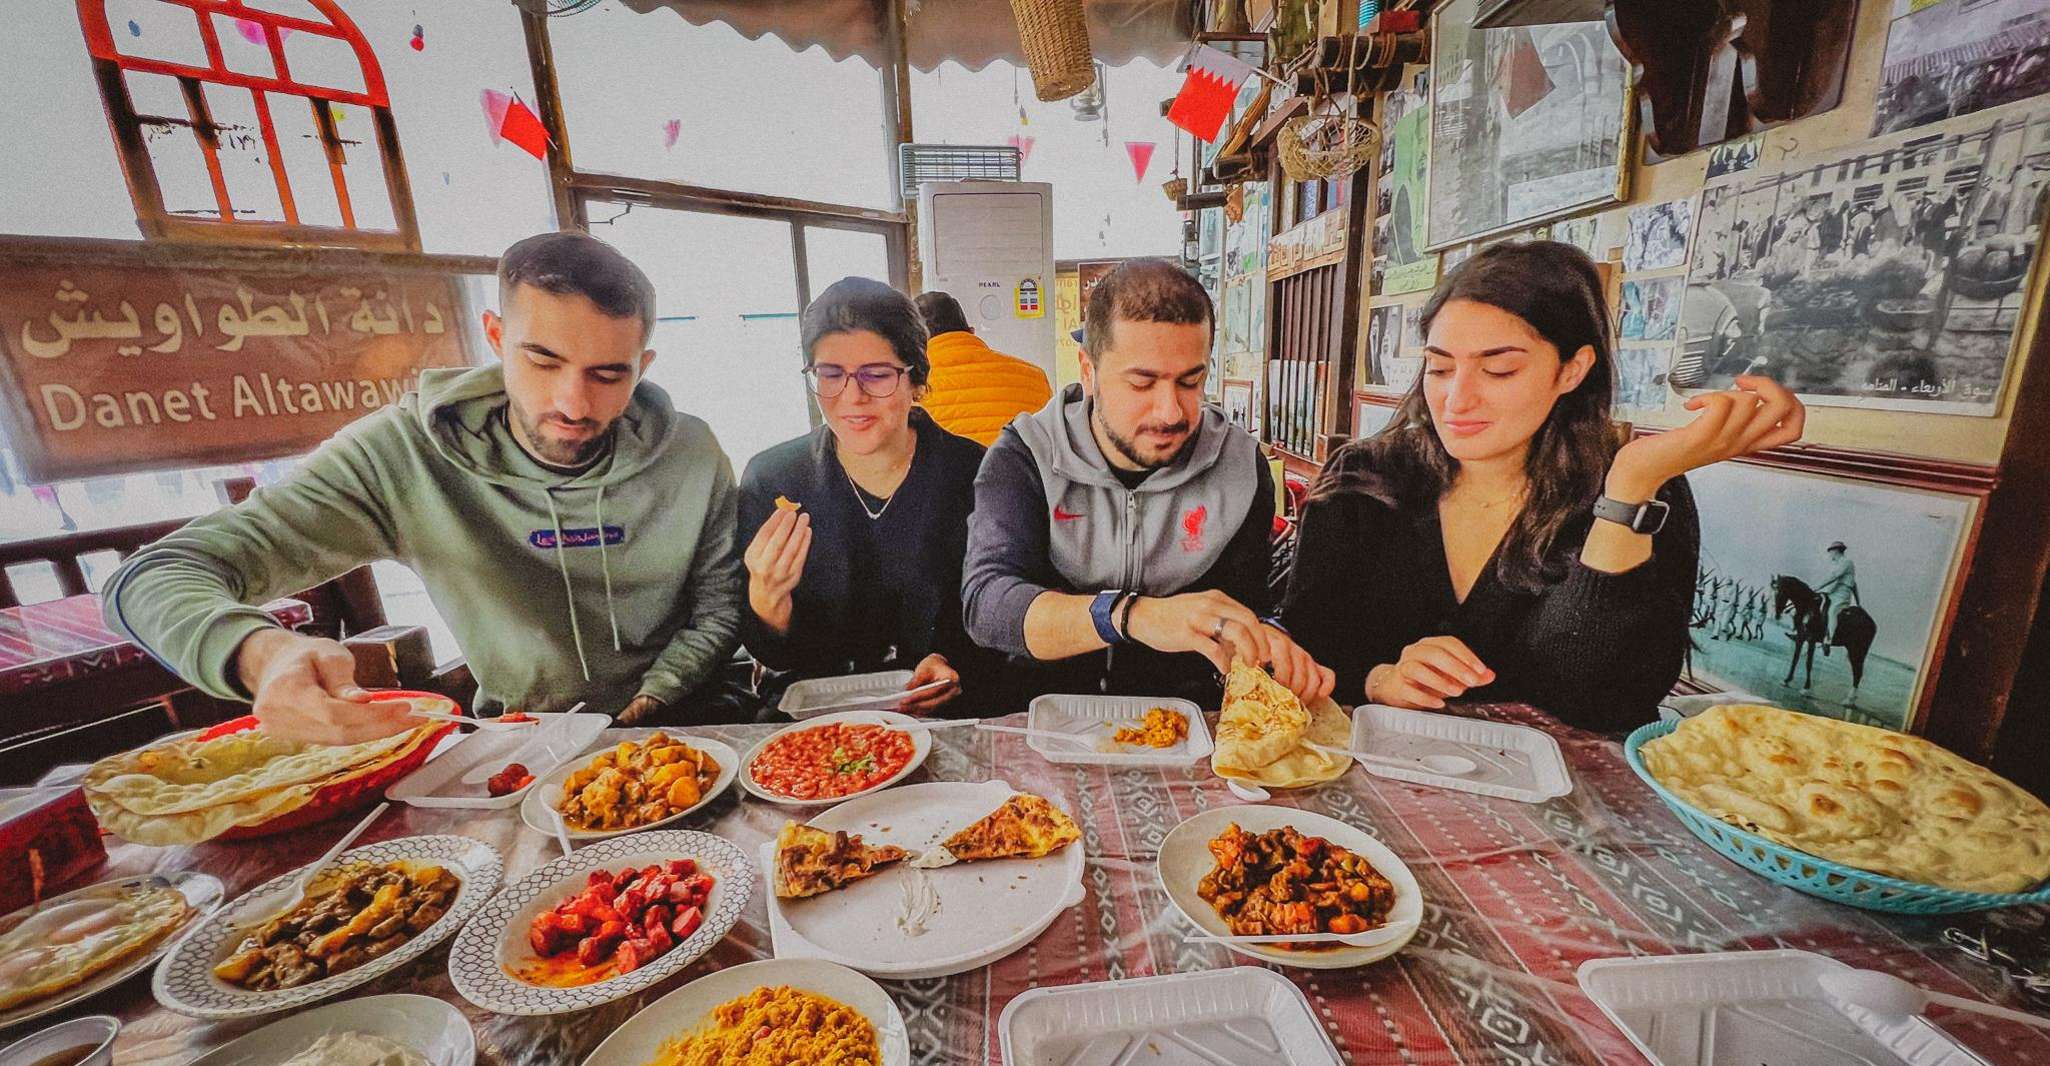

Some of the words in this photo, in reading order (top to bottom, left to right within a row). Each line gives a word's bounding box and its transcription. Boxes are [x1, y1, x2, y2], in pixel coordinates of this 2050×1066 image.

[21, 278, 332, 359] الطواويش
[339, 285, 446, 338] دانة
[40, 380, 217, 432] Danet
[233, 368, 416, 418] Altawawi
[1911, 378, 1957, 397] الأربعاء
